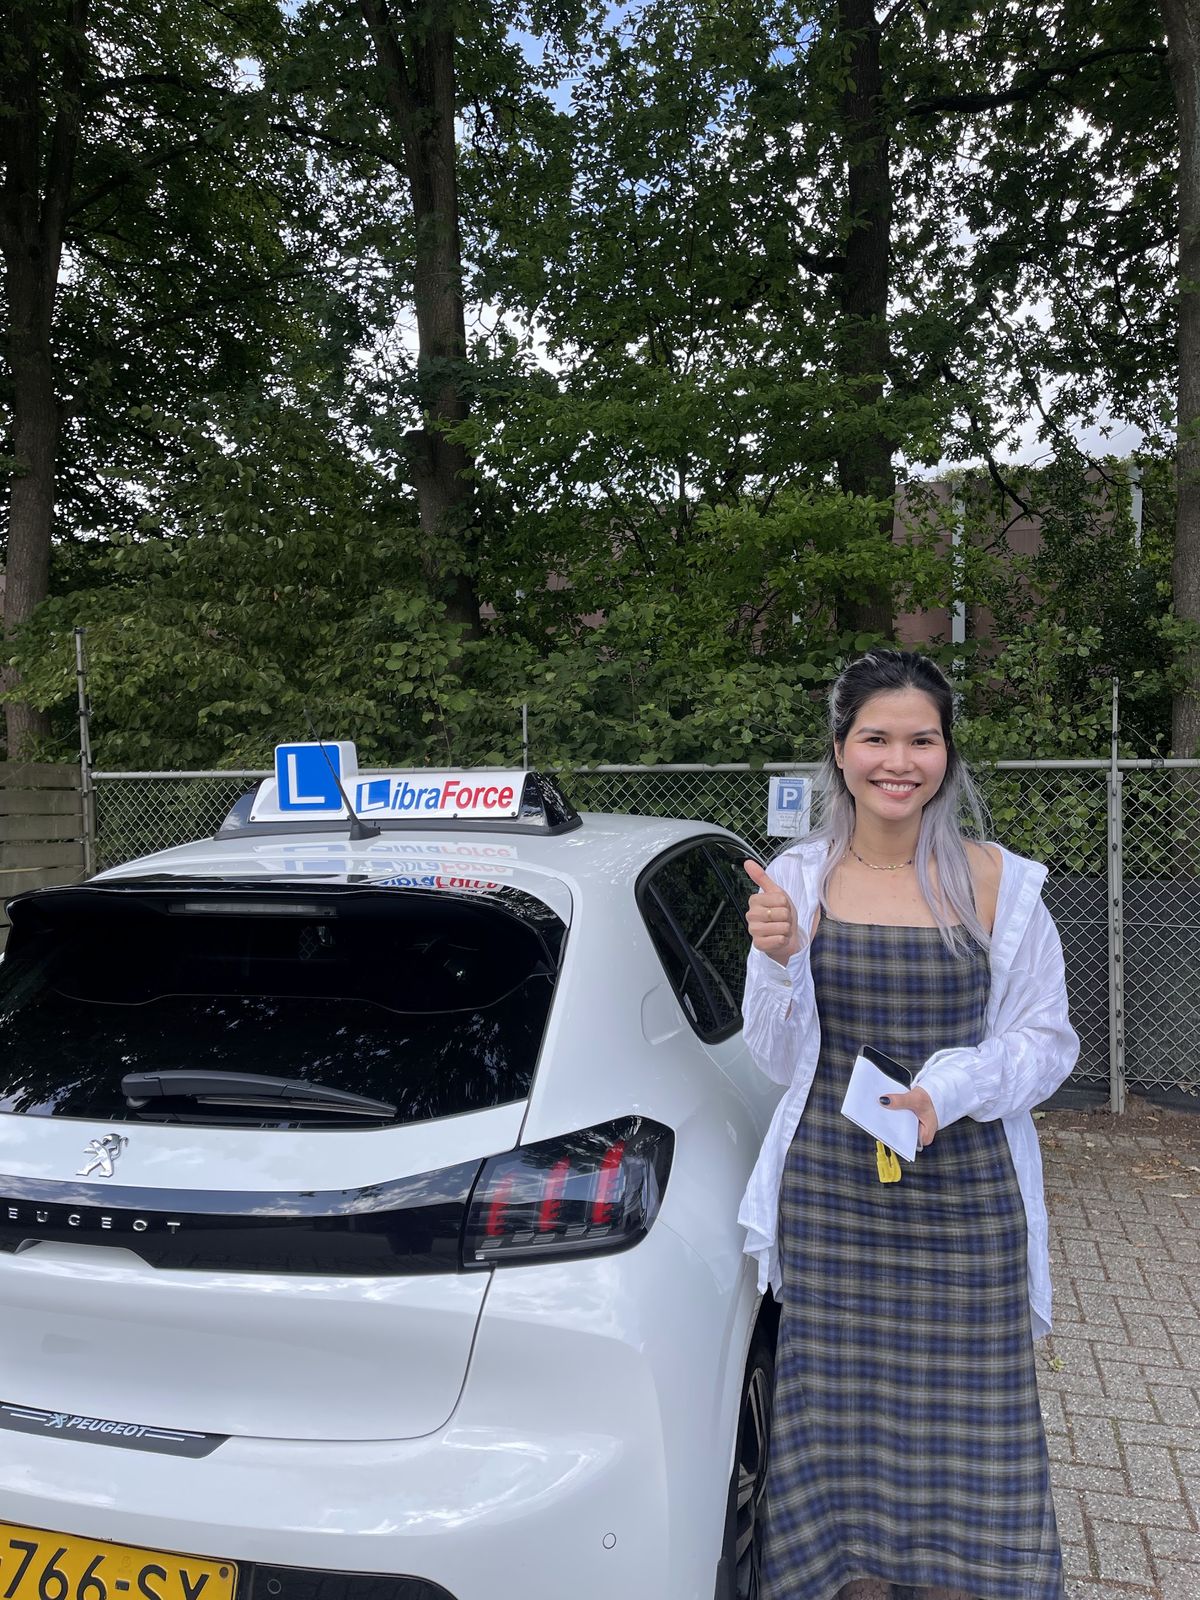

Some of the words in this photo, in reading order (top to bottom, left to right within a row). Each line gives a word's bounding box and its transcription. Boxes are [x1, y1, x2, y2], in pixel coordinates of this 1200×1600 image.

[287, 753, 325, 805] L
[356, 779, 514, 814] LibraForce
[782, 787, 799, 808] P
[66, 1415, 151, 1438] PEUGEOT
[0, 1539, 210, 1600] 766-S
